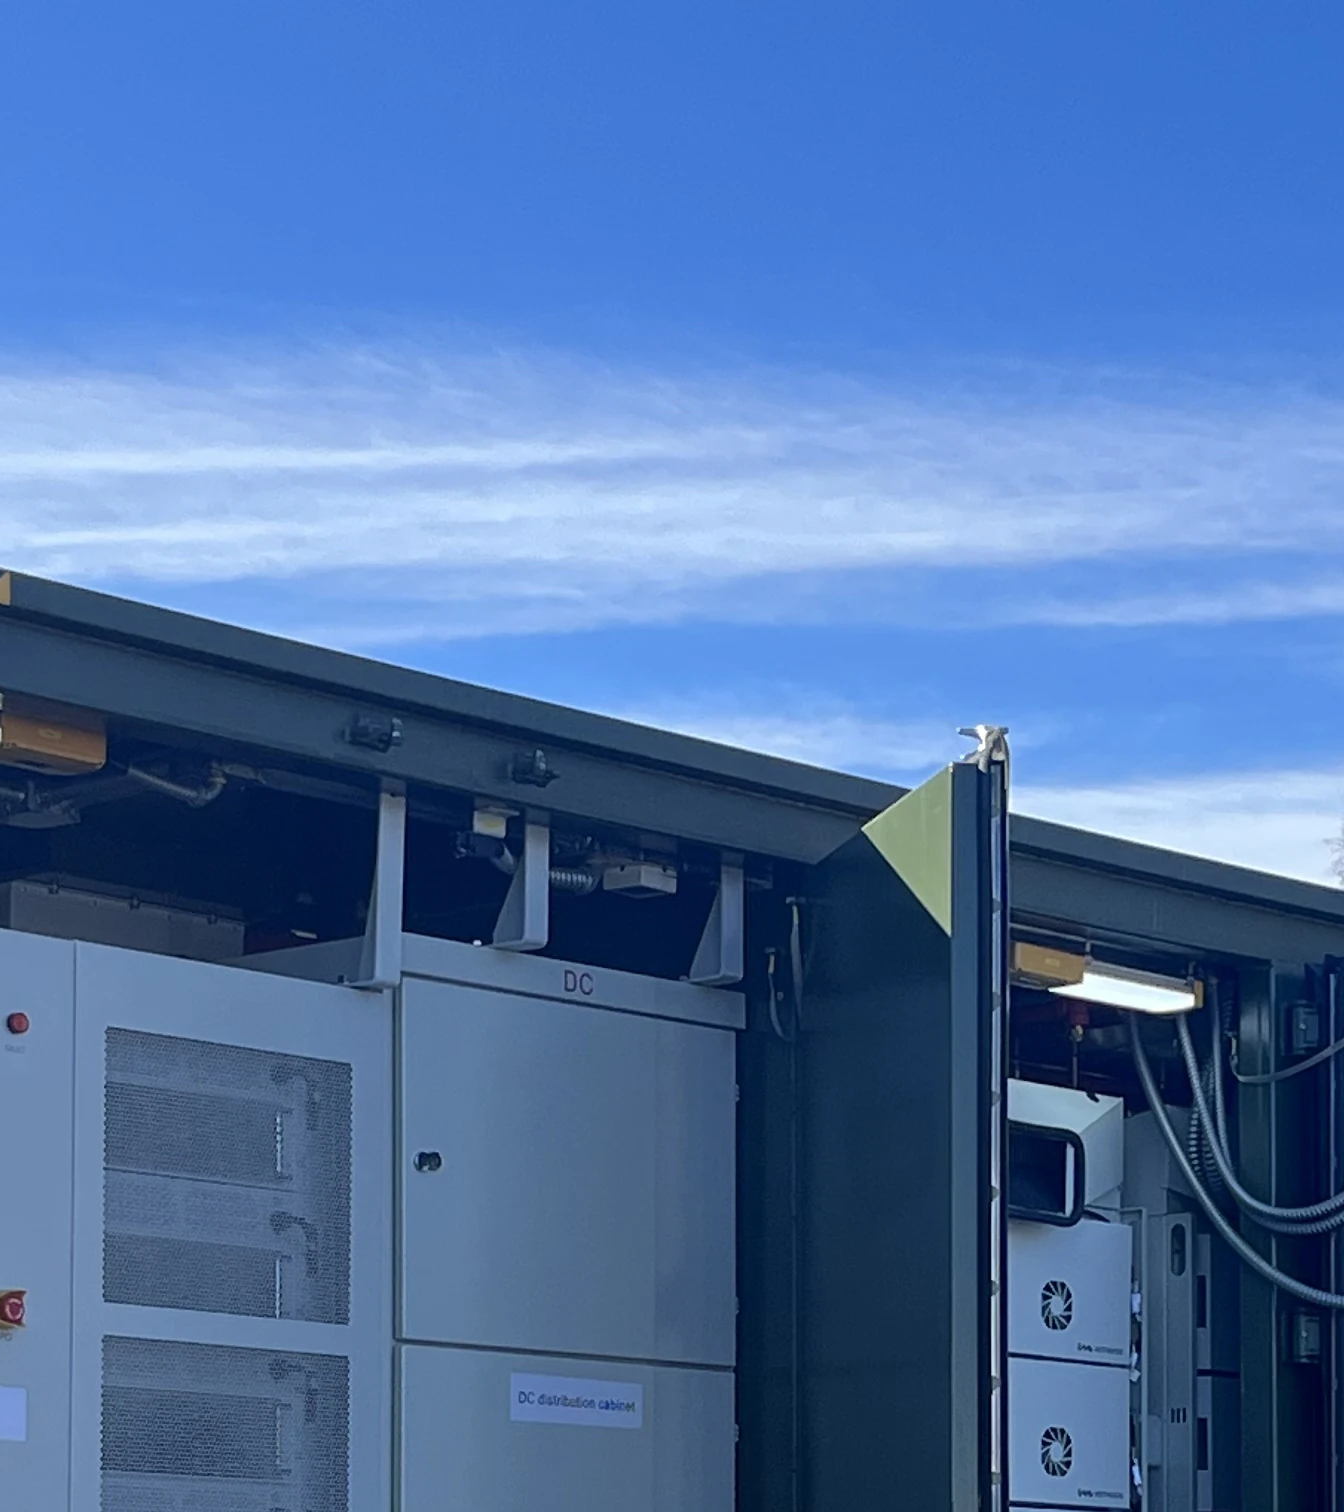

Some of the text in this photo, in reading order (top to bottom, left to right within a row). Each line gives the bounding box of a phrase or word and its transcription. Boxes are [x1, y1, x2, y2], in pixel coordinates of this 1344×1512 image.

[563, 968, 594, 996] DC
[517, 1390, 535, 1405] DC
[598, 1398, 636, 1413] cabinet
